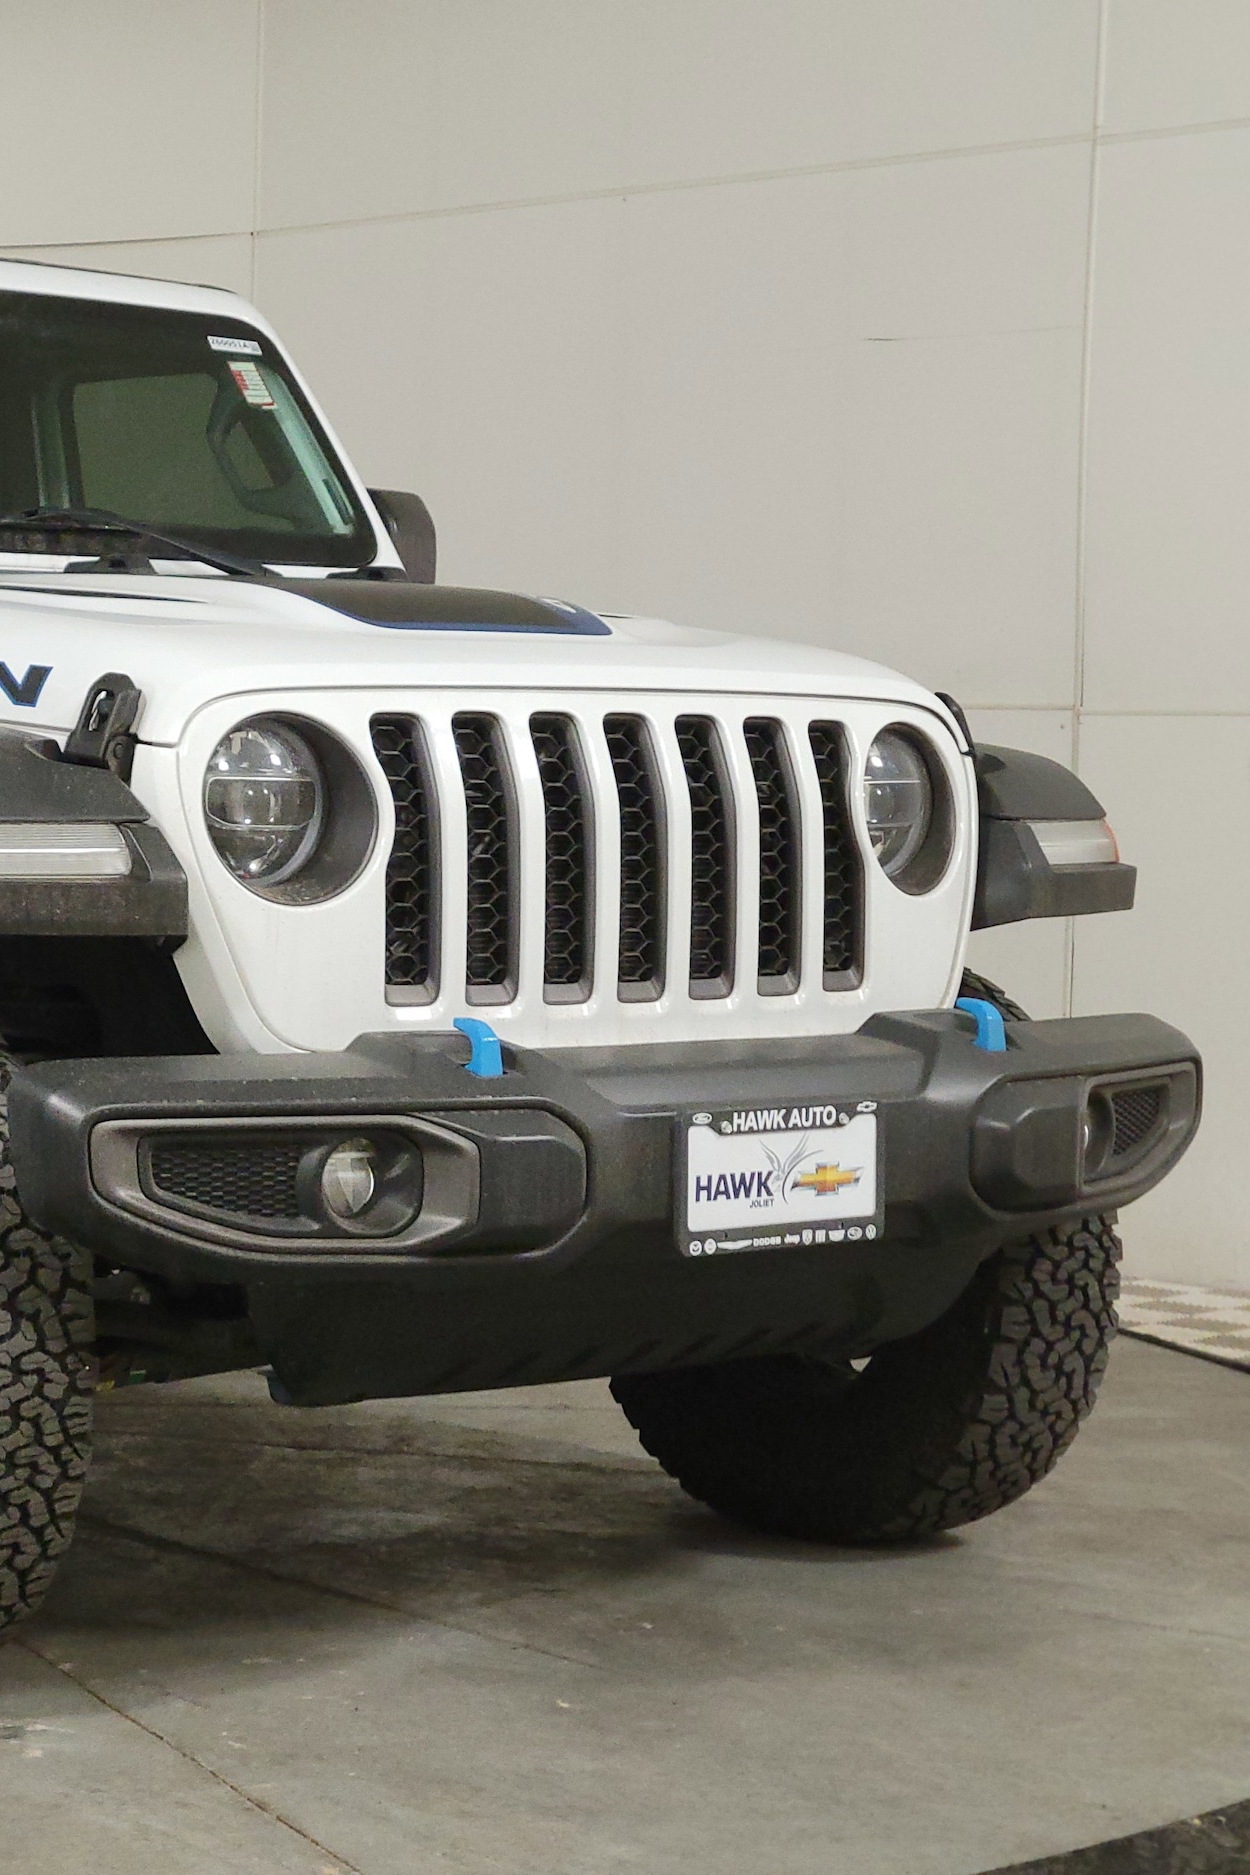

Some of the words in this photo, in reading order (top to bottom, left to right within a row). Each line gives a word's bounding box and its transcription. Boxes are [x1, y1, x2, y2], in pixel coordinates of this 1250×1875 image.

[733, 1109, 787, 1133] HAWK
[788, 1106, 837, 1128] AUTO
[695, 1170, 775, 1203] HAWK
[749, 1198, 775, 1209] JOLIET
